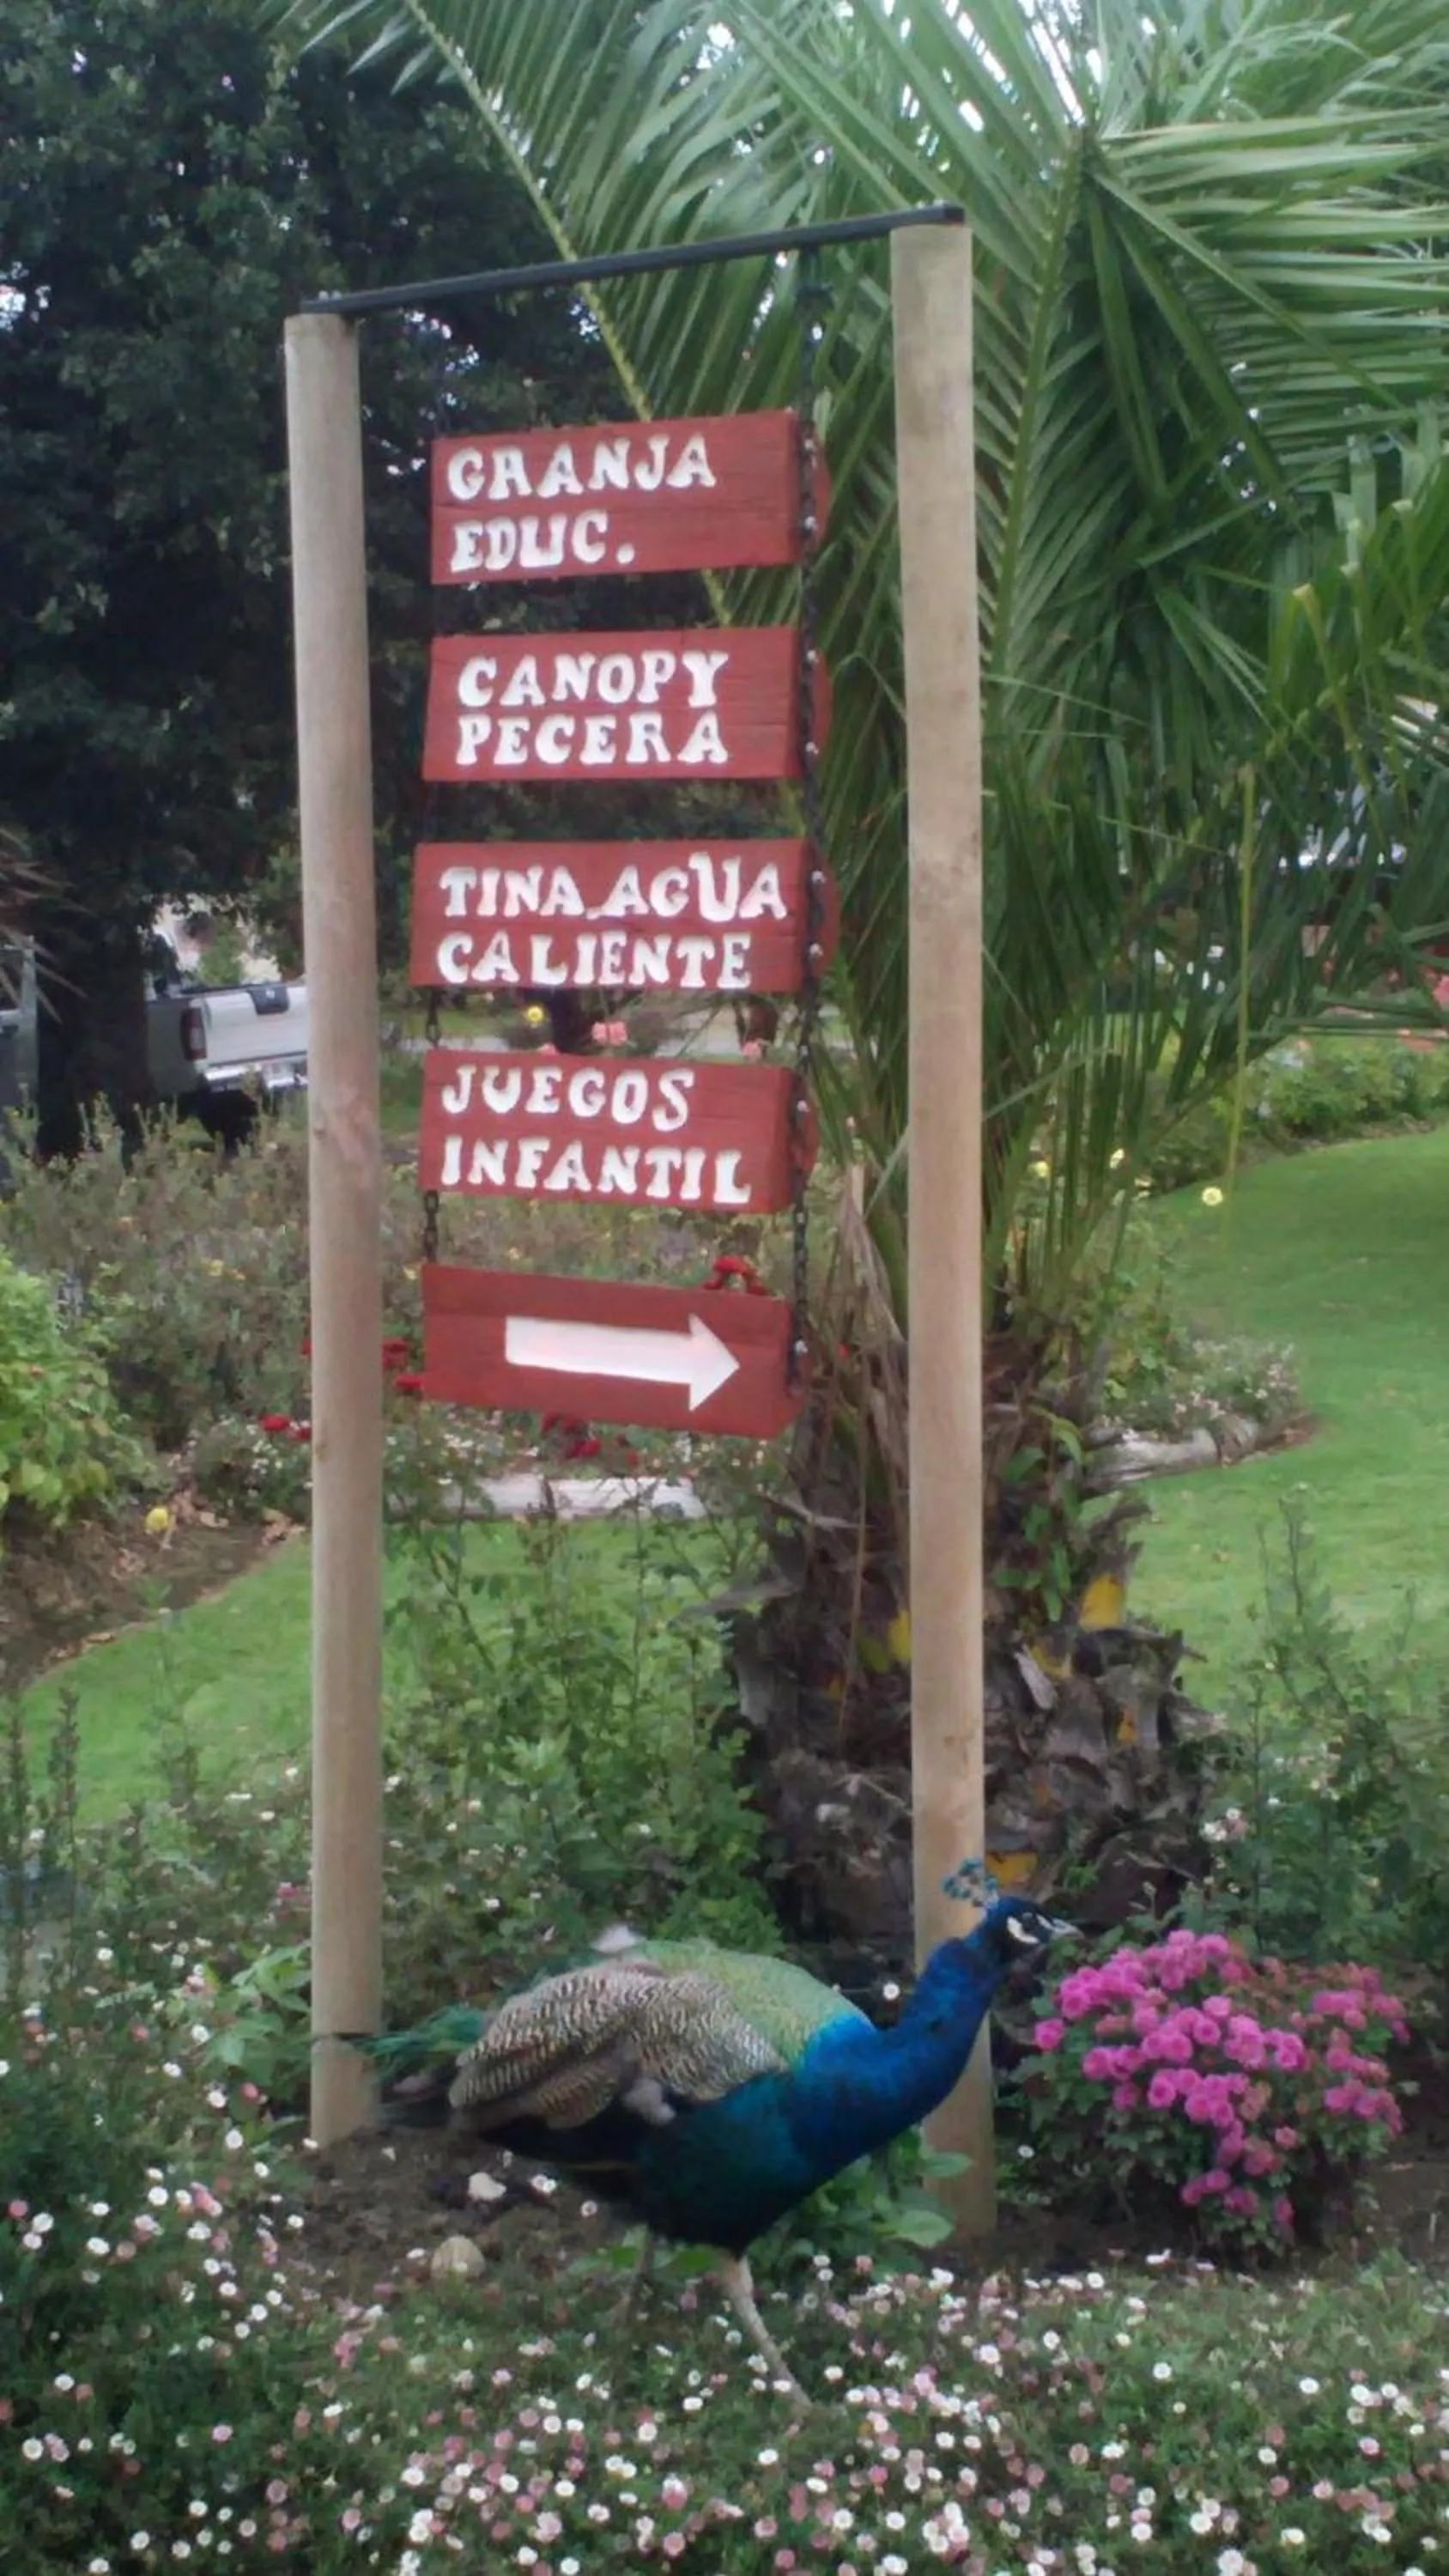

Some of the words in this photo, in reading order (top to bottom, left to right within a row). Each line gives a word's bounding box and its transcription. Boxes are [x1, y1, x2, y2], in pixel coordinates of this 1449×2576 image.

[446, 434, 718, 501] GRANJA
[449, 508, 636, 574] EDUC.
[457, 649, 730, 709] CANOPY
[455, 710, 730, 767] PECERA
[592, 852, 788, 924] AGUA
[436, 930, 752, 990] CALIENTE
[441, 1065, 696, 1133] JUEGOS
[440, 1134, 752, 1205] INFANTIL
